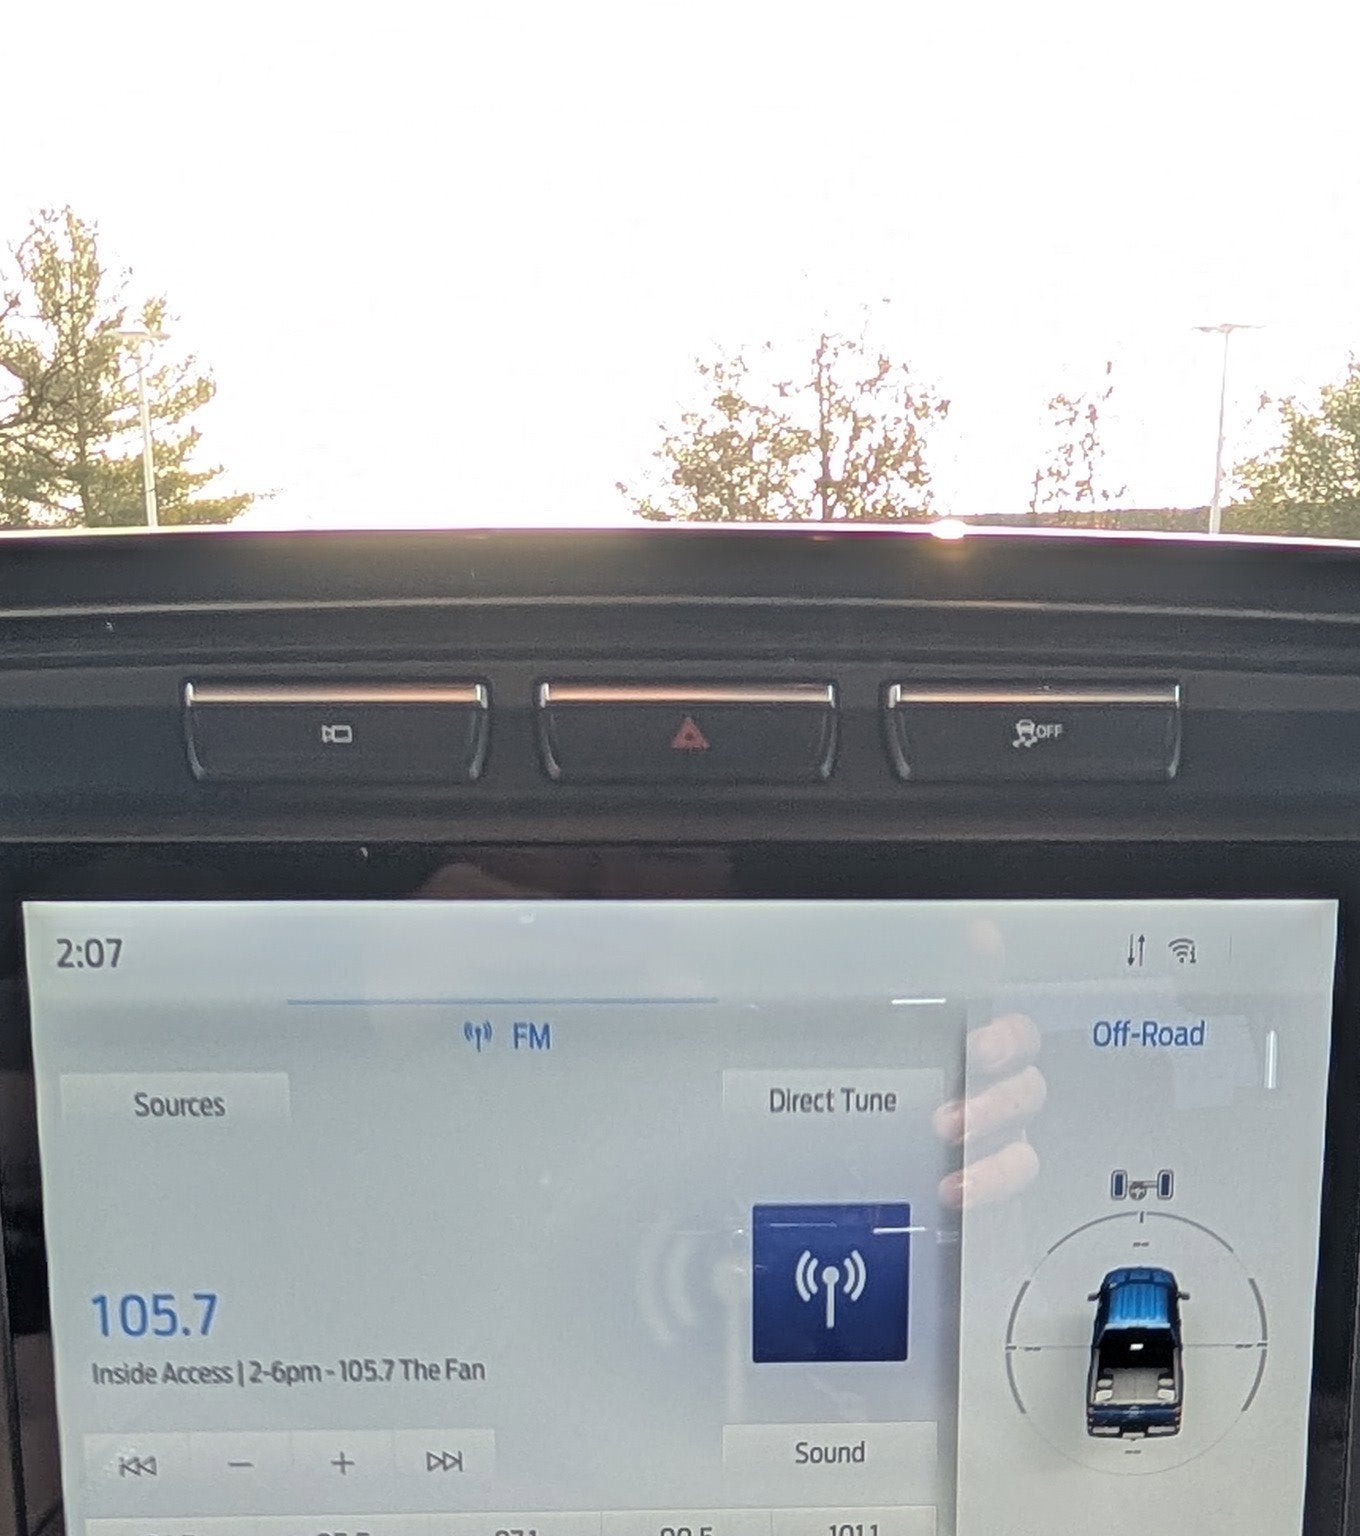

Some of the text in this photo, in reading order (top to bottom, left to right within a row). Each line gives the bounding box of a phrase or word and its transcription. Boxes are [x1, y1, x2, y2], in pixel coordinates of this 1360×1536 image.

[1036, 725, 1062, 738] OFF
[57, 939, 122, 968] 2:07
[514, 1023, 550, 1049] FM
[1094, 1020, 1204, 1047] Off-Road
[135, 1093, 225, 1117] Sources
[770, 1088, 896, 1112] Direct Tune
[92, 1294, 216, 1336] 105.7
[92, 1362, 157, 1384] Inside
[162, 1362, 234, 1384] Access
[250, 1361, 321, 1386] 2-6pm
[339, 1359, 394, 1382] 105.7
[399, 1359, 440, 1381] The
[446, 1359, 485, 1380] Fan
[796, 1441, 864, 1463] Sound
